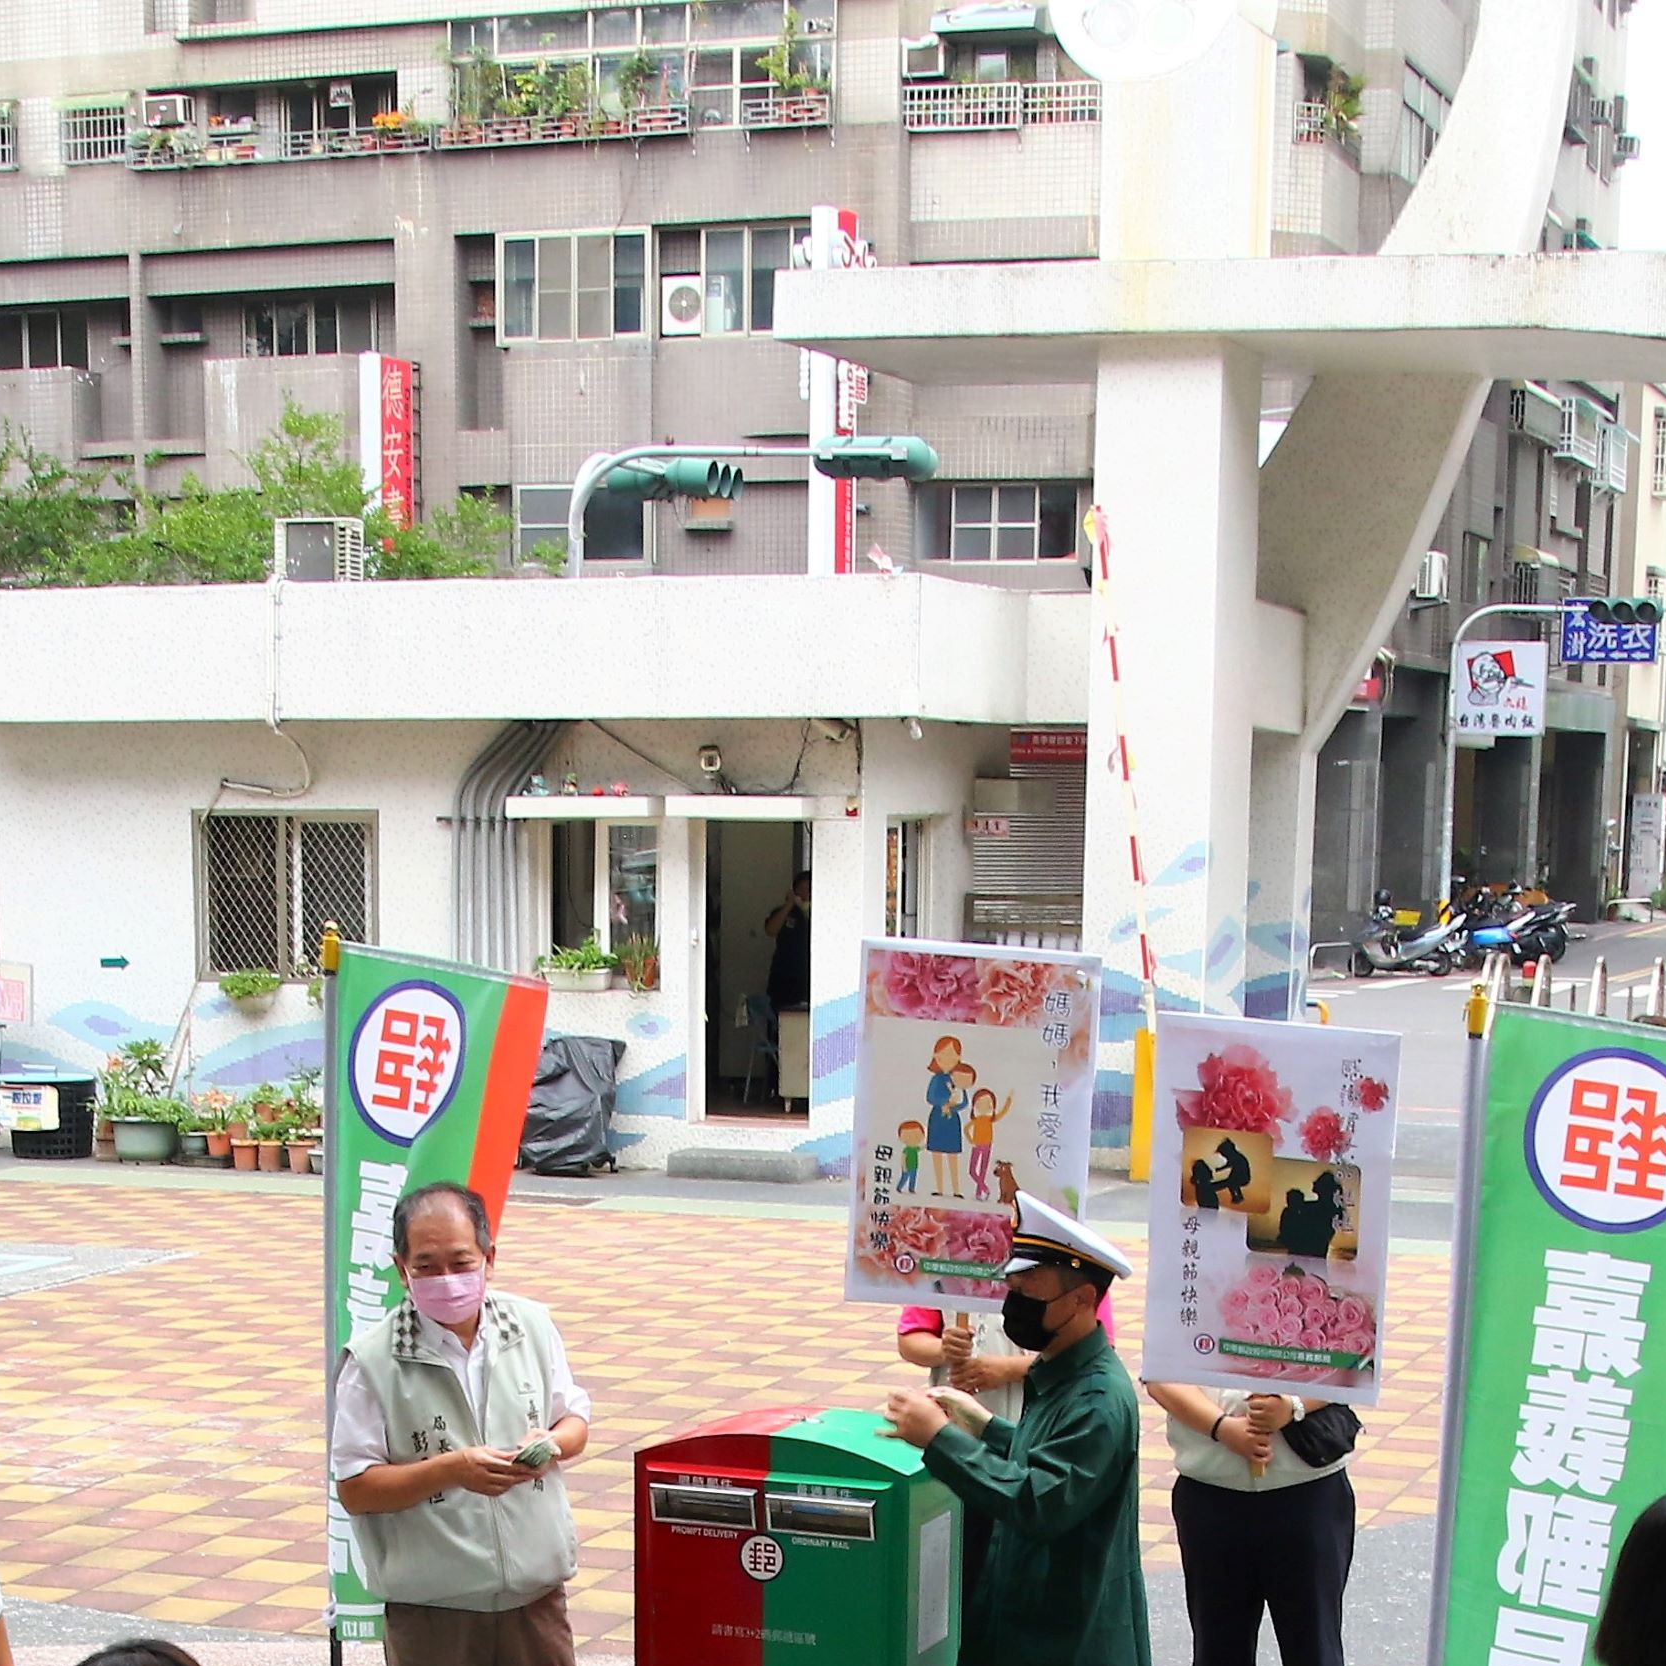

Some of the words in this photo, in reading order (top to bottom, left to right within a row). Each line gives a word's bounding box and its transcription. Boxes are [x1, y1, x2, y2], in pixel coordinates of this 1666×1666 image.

[869, 1144, 894, 1250] 母親節快樂
[1180, 1216, 1202, 1327] 母親節快樂
[671, 1524, 702, 1537] PROMPT
[703, 1528, 739, 1540] DELIVERY
[792, 1536, 830, 1548] ORDINARY
[832, 1540, 851, 1550] MAIL
